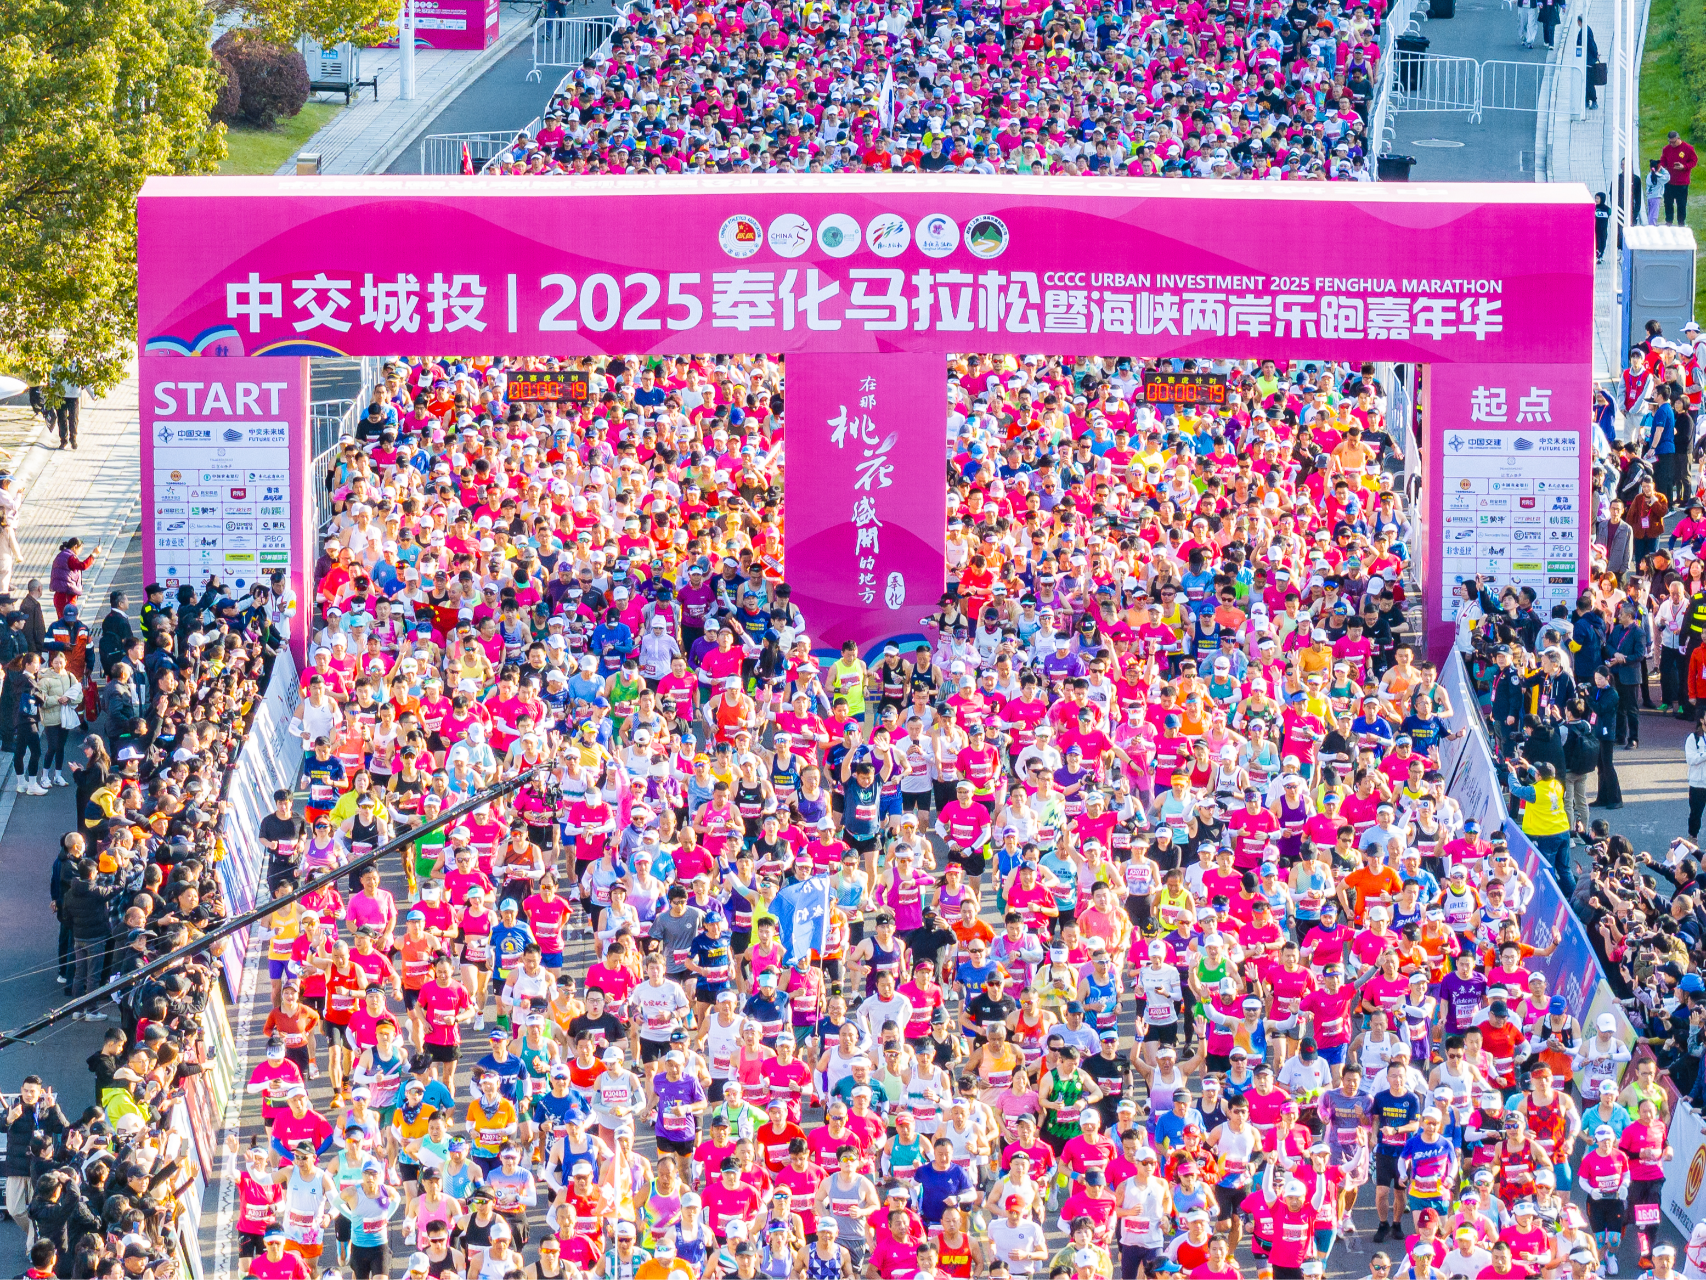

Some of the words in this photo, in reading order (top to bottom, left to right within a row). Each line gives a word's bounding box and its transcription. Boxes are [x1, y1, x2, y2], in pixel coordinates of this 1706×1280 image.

[1043, 272, 1087, 286] CCCC
[1091, 273, 1150, 288] URBAN
[1156, 274, 1266, 290] INVESTMENT
[1270, 276, 1310, 291] 2025
[1315, 277, 1397, 293] FENGHUA
[1402, 279, 1503, 294] MARATHON
[226, 273, 488, 333] 中交城投
[1043, 289, 1503, 341] 暨海峡两岸乐跑嘉年华
[154, 381, 288, 416] START
[1146, 382, 1225, 403] 00:00:19
[1470, 385, 1553, 424] 起点
[249, 428, 285, 436] 中交未来城
[1468, 438, 1502, 446] 中国交建
[1539, 437, 1576, 446] 中交未来城
[1638, 1209, 1660, 1220] 16:00
